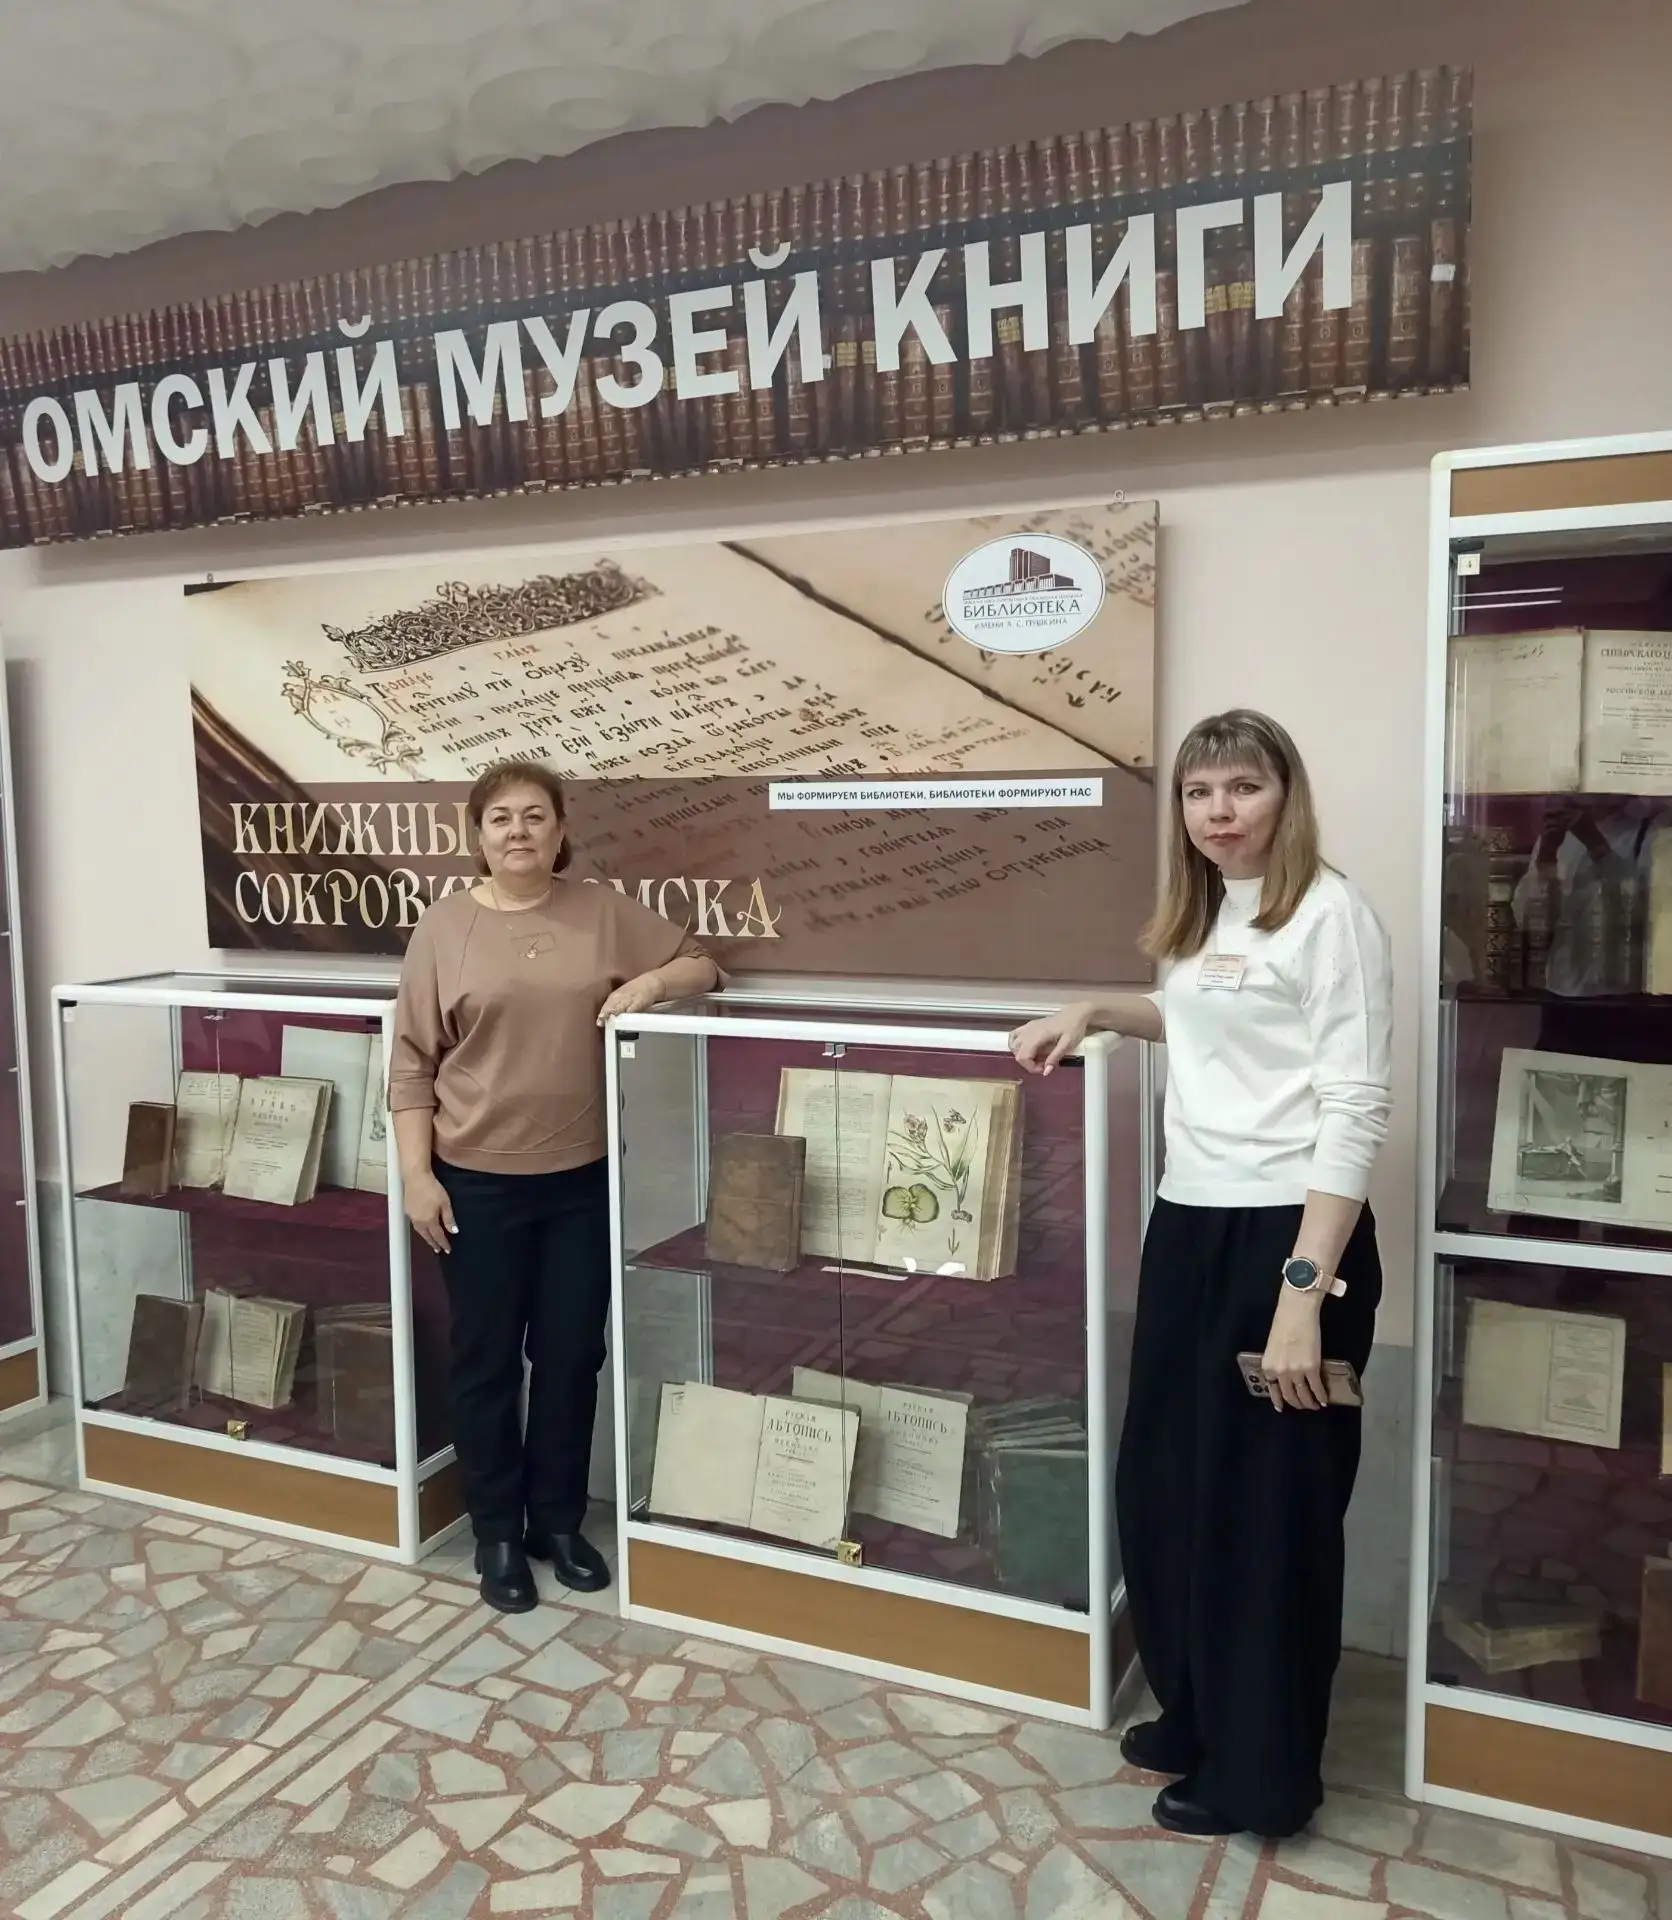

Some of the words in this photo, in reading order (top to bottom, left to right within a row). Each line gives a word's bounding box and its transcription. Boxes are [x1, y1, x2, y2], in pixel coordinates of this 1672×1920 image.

[22, 314, 405, 483] ОМСКИЙ
[434, 241, 824, 430] МУЗЕЙ
[871, 180, 1352, 373] КНИГИ
[963, 599, 1081, 618] БИБЛИОТЕКА
[974, 622, 1004, 630] ИМЕНИ
[1025, 617, 1068, 627] ПУШКИНА
[777, 792, 795, 801] МЫ
[797, 791, 858, 801] ФОРМИРУЕМ
[860, 790, 927, 800] БИБЛИОТЕКИ,
[929, 789, 996, 799] БИБЛИОТЕКИ
[998, 787, 1067, 798] ФОРМИРУЮТ
[1070, 787, 1092, 797] НАС
[230, 802, 474, 857] КНИЖНЫ
[234, 868, 491, 928] СОКРОВ
[582, 876, 783, 938] СКА
